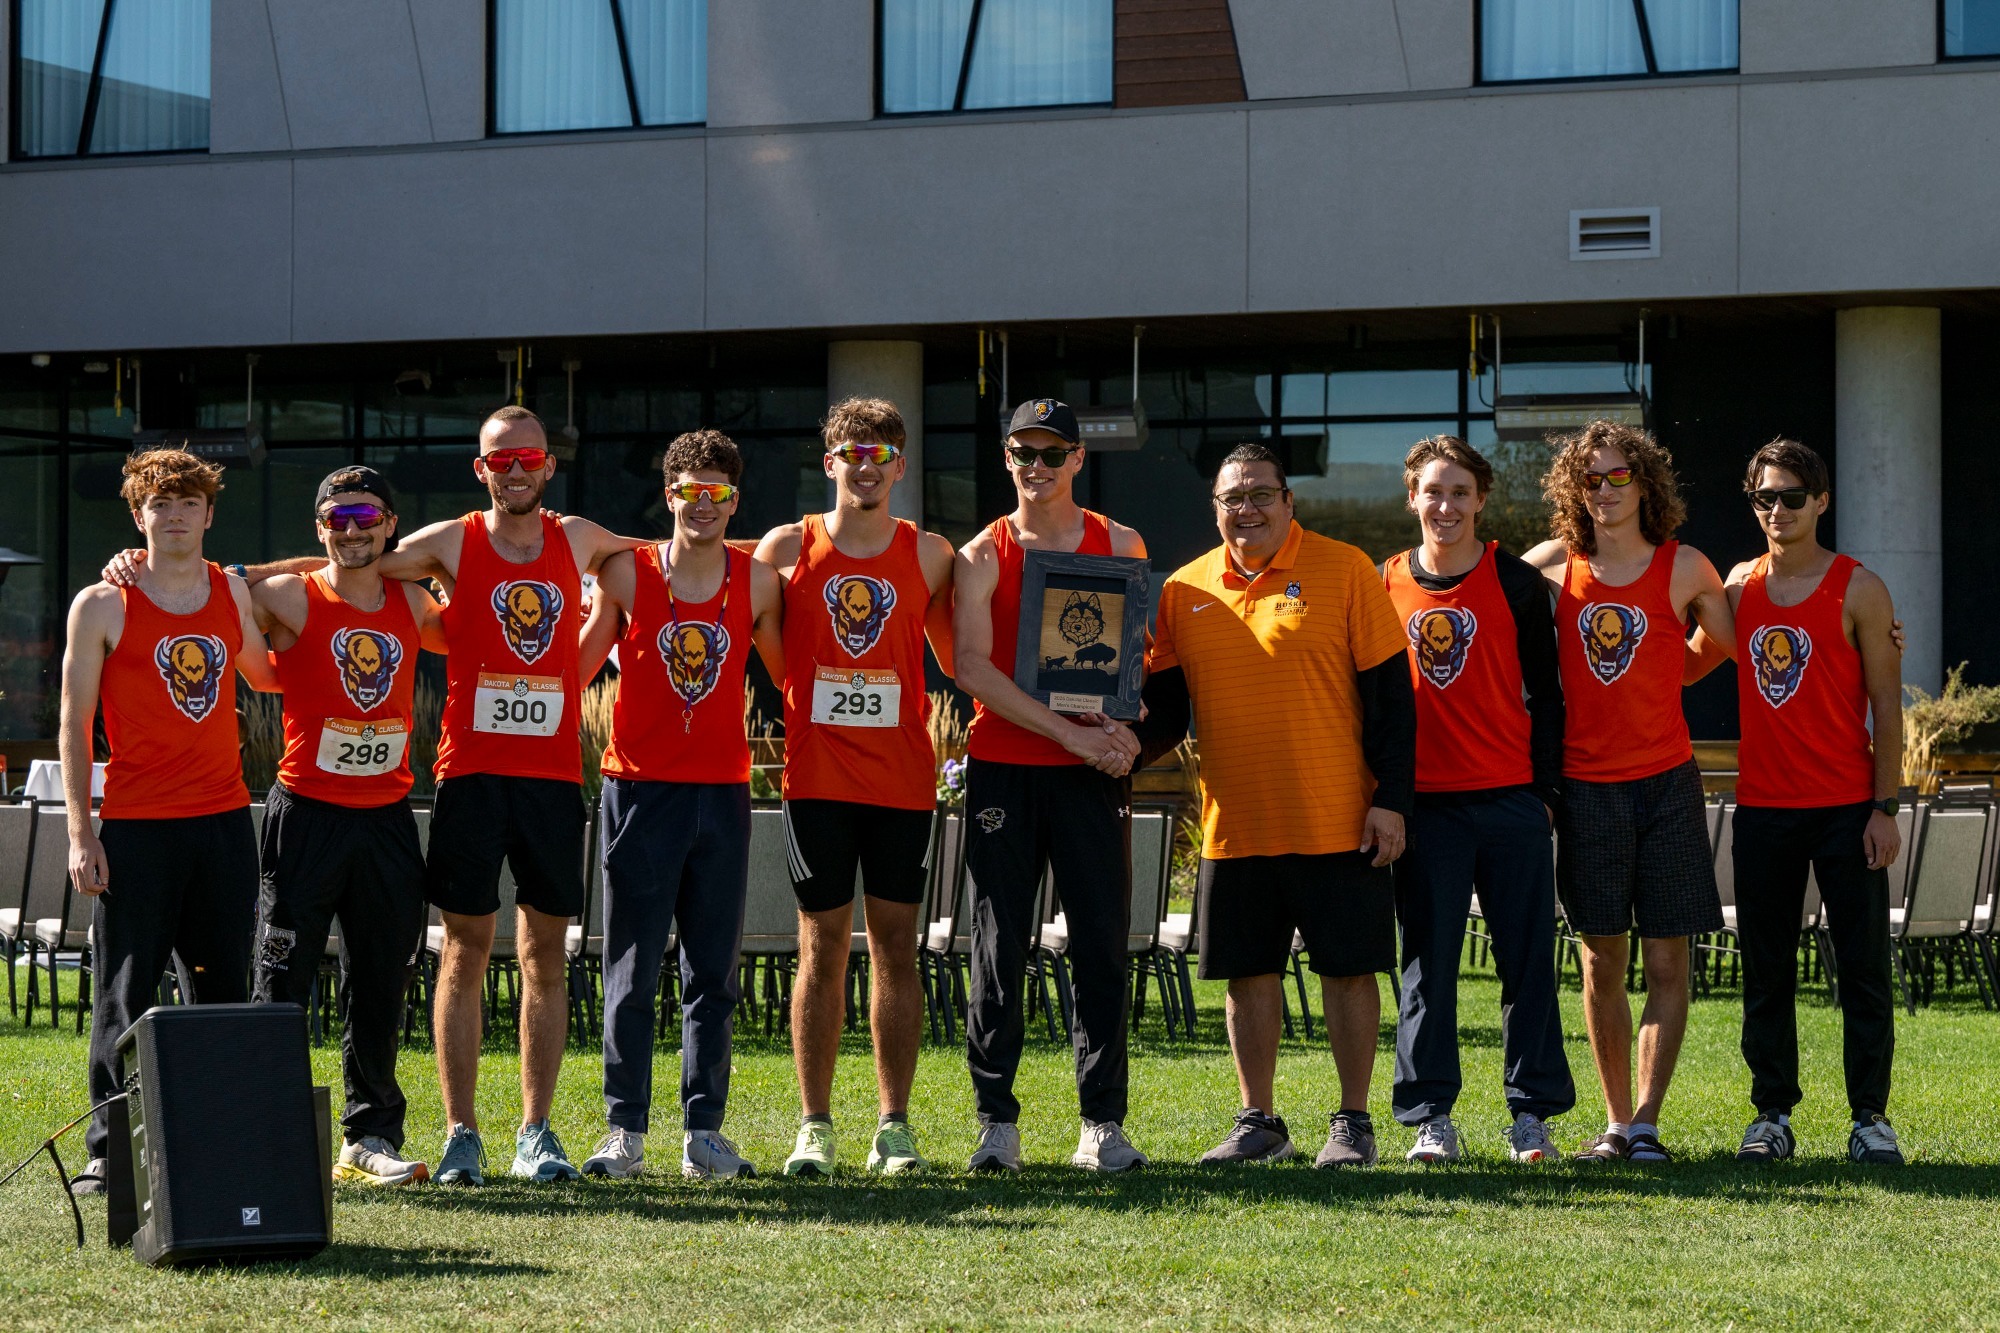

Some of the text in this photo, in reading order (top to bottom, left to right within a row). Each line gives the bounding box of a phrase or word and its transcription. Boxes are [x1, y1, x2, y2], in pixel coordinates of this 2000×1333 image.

[484, 679, 559, 691] DAKOTA CLASSIC
[821, 672, 848, 682] DAKOTA
[492, 698, 547, 724] 300
[831, 691, 882, 716] 293
[330, 721, 404, 734] DAKOTA CLASSIC
[337, 742, 390, 766] 298
